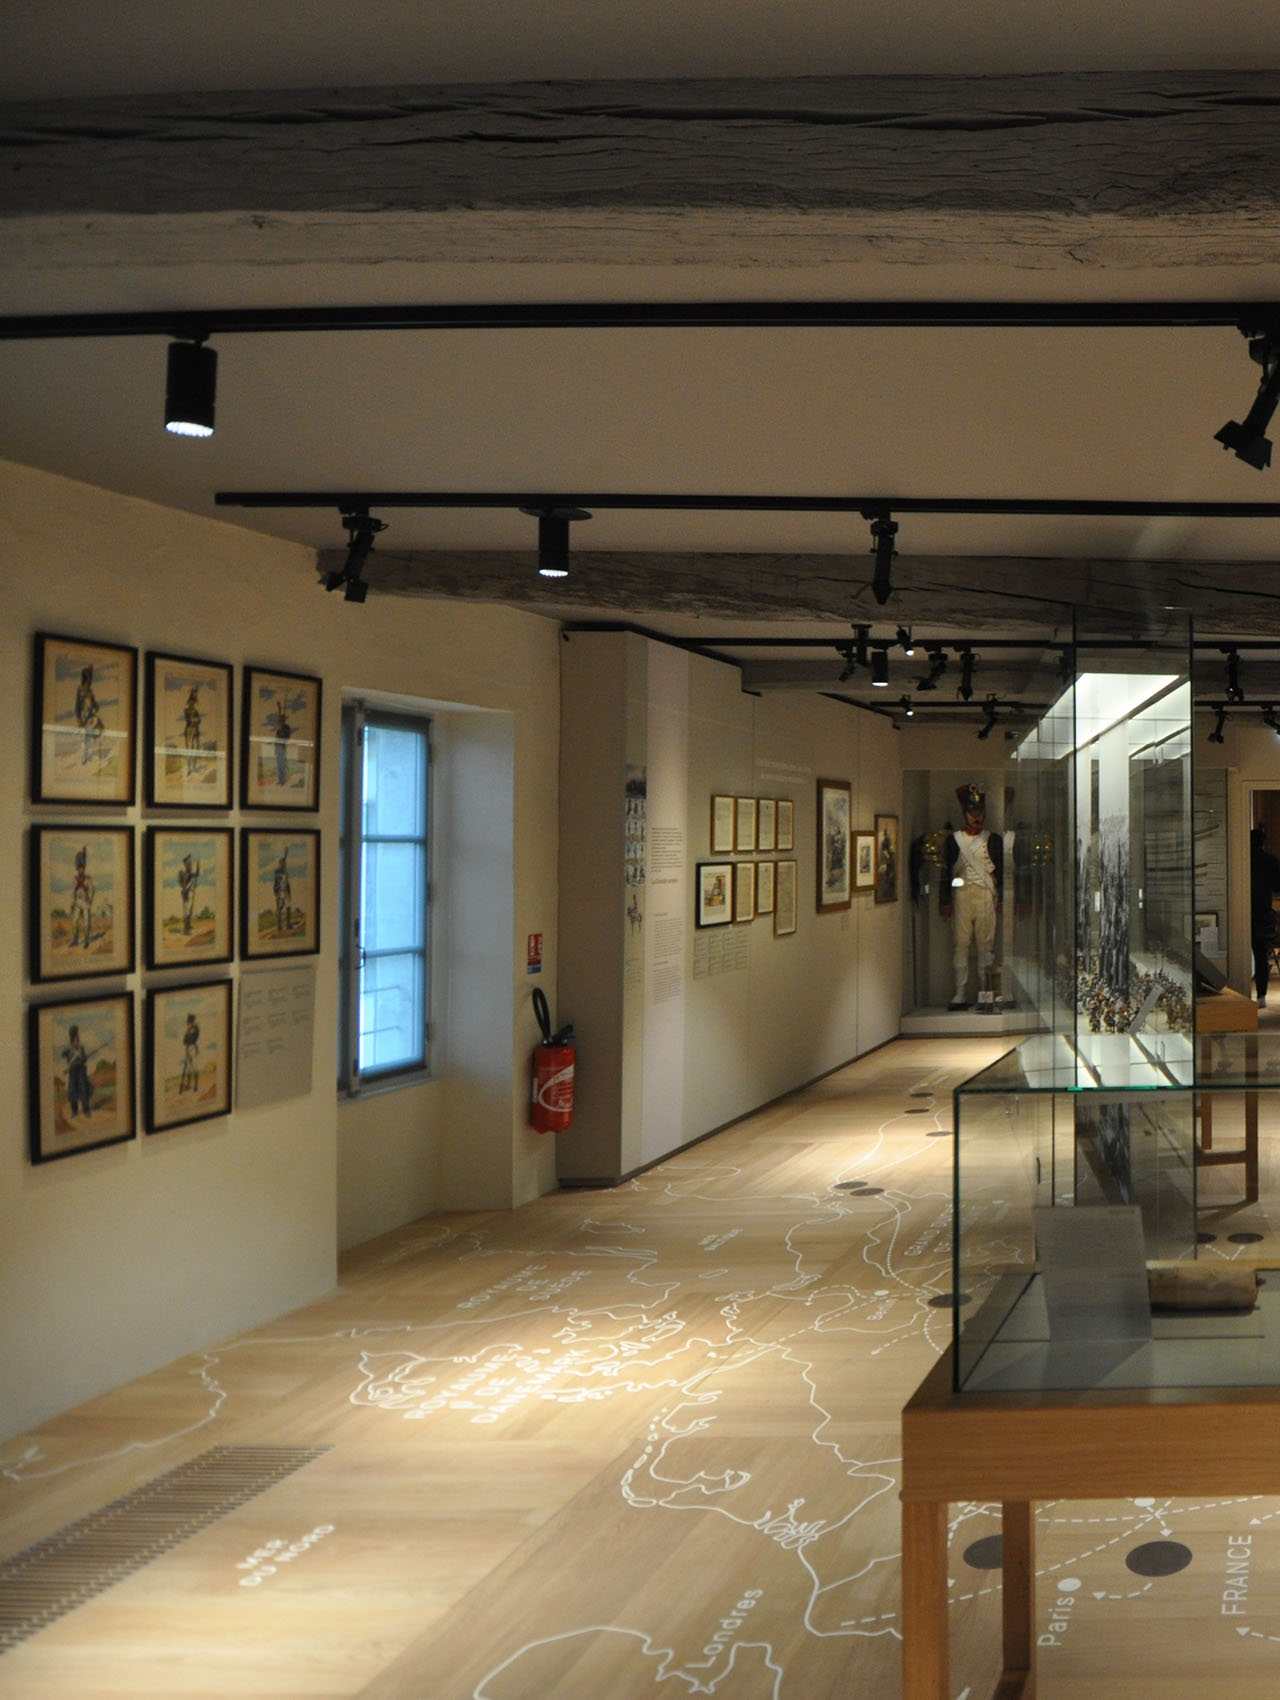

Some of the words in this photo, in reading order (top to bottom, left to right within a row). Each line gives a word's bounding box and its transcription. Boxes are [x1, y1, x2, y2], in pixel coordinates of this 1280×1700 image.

[1221, 1535, 1252, 1616] FRANCE
[685, 1589, 763, 1668] Londres
[1037, 1597, 1075, 1646] Paris
